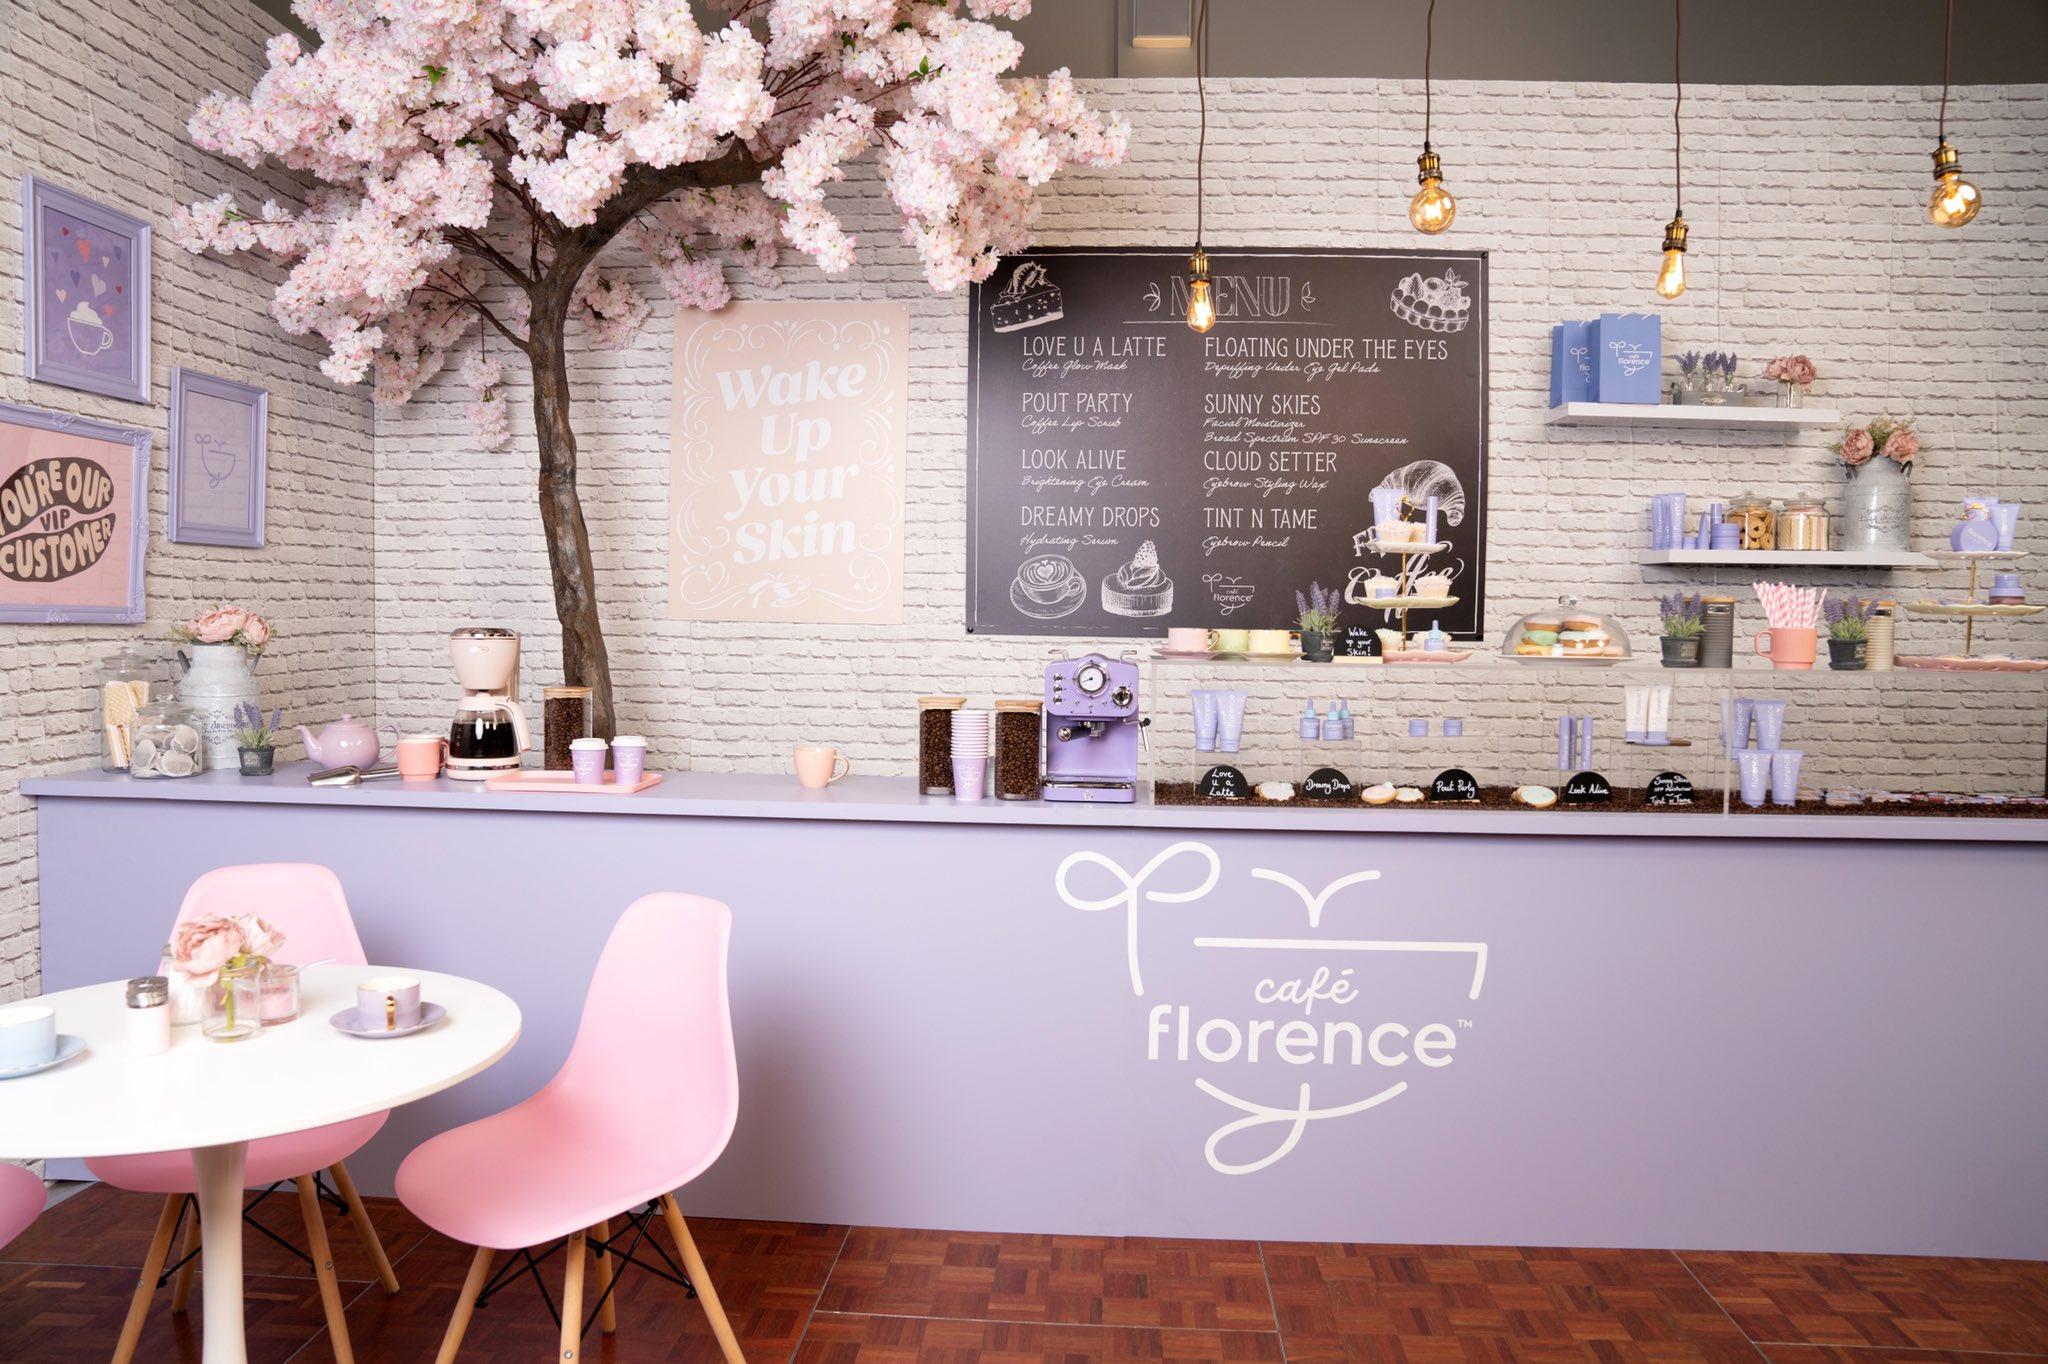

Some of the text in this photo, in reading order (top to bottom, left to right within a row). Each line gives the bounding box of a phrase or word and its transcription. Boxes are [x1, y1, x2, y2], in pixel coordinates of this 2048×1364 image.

[1023, 336, 1167, 358] LOVE U A LATTE
[1205, 337, 1449, 361] FLOATING UNDER THE EYES
[1022, 358, 1128, 379] Coffee Glow Mask
[1204, 361, 1381, 383] Depuffing Under Eye Gel Pads
[1618, 357, 1651, 366] florence
[715, 360, 867, 412] Wake
[1022, 392, 1133, 413] POUT PARTY
[1204, 393, 1321, 415] SUNNY SKIES
[1021, 414, 1122, 435] Coffee Lip Scrub
[1203, 417, 1306, 438] Facial Moisturizer
[761, 411, 832, 463] Up
[1203, 432, 1409, 448] Broad Spectrum SPF 30 Sunscreen
[1022, 449, 1127, 470] LOOK ALIVE
[1203, 450, 1338, 473] CLOUD SETTER
[722, 463, 861, 521] your
[1021, 474, 1150, 496] Brightening Eye Cream
[1203, 477, 1330, 498] Eyebrow Styling Wax
[0, 460, 112, 537] OU'RE OUR
[40, 508, 71, 532] VIP
[1021, 506, 1160, 528] DREAMY DROPS
[1203, 508, 1318, 530] TINT N TAME
[0, 518, 113, 579] CUSTOMER
[731, 510, 857, 565] Skin
[1019, 532, 1120, 554] Hydrating Serum
[1202, 536, 1290, 556] Eyebrow Pencil
[1348, 626, 1368, 637] Wake
[1345, 639, 1373, 649] up your
[1346, 646, 1371, 657] Skin!
[1767, 704, 1777, 737] florence
[1211, 768, 1235, 779] Love
[1751, 753, 1760, 788] florence
[1783, 754, 1792, 788] florence
[1208, 787, 1235, 797] Latte
[1305, 778, 1351, 795] Dreamy Drops
[1435, 780, 1477, 799] Pout Party
[1567, 783, 1610, 795] Look Alive
[1254, 965, 1360, 1016] café
